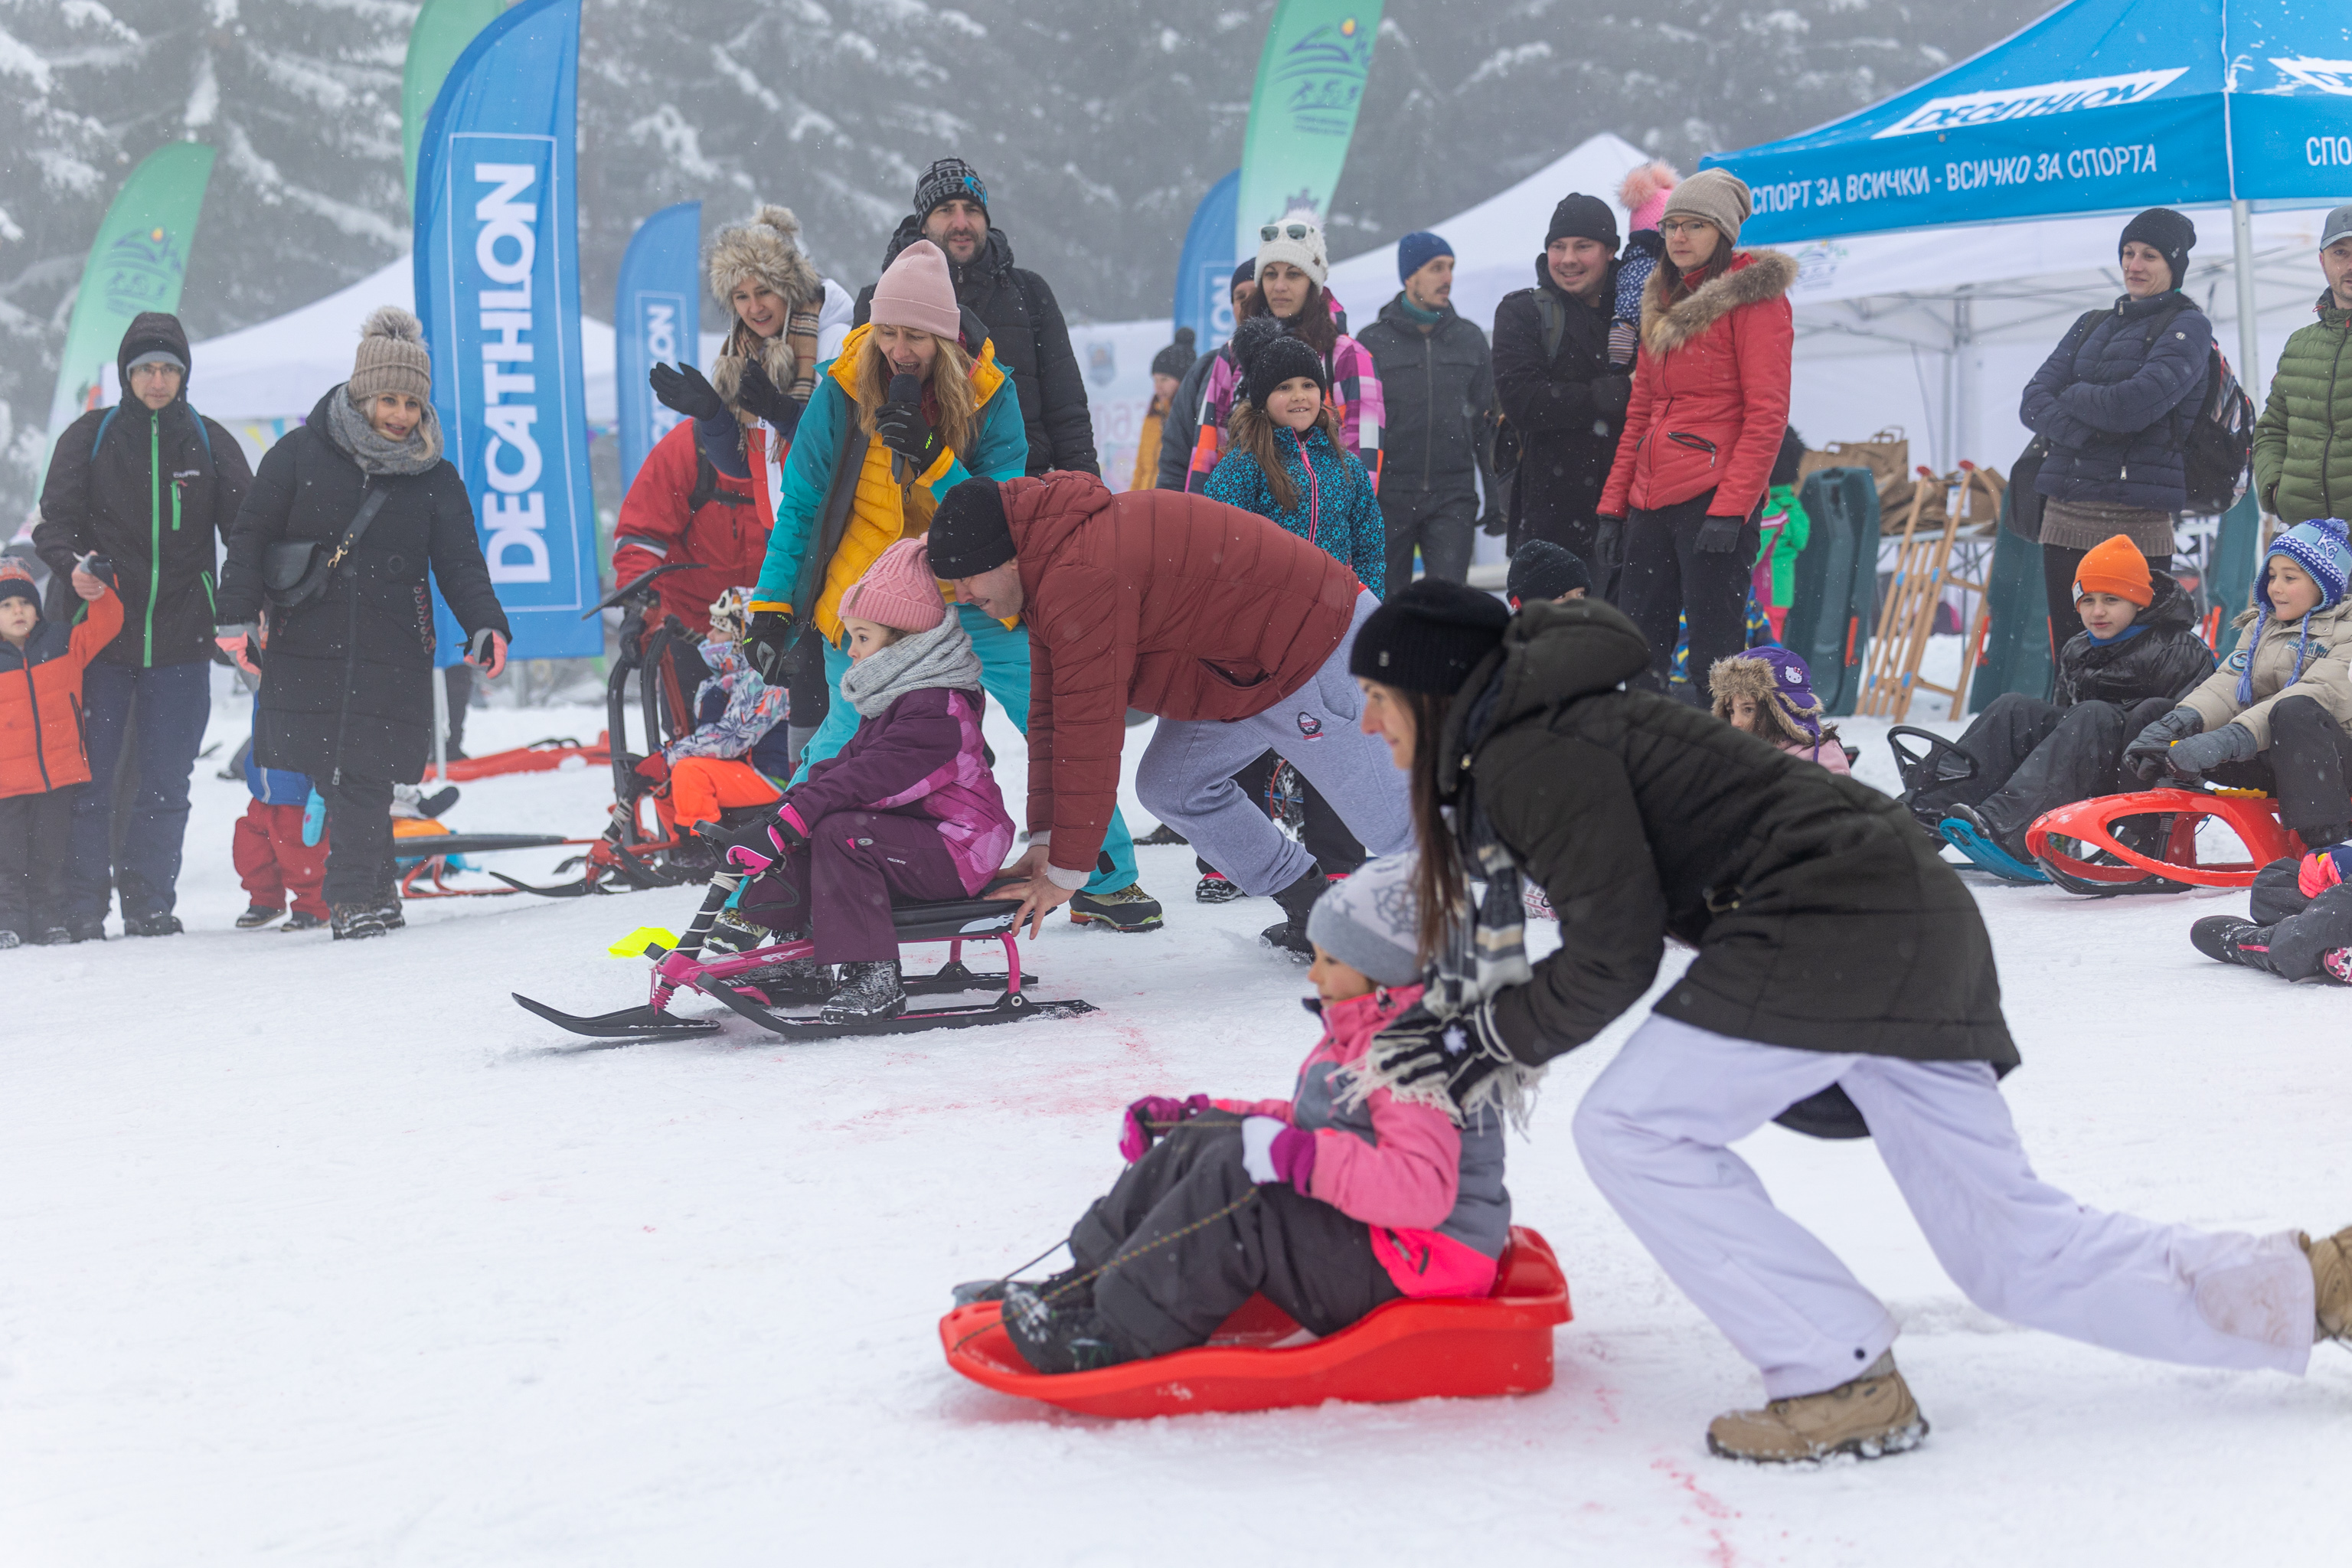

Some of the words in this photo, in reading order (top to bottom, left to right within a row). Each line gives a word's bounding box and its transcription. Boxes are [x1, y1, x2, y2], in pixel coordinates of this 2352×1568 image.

[1751, 179, 1812, 215] СПОРТ
[1815, 176, 1841, 207] ЗА
[1846, 165, 1930, 204] ВСИЧКИ
[1945, 155, 2031, 191] ВСИЧКО
[2034, 152, 2063, 182] ЗА
[2067, 144, 2157, 179] СПОРТА
[475, 162, 551, 583] DECATHLON
